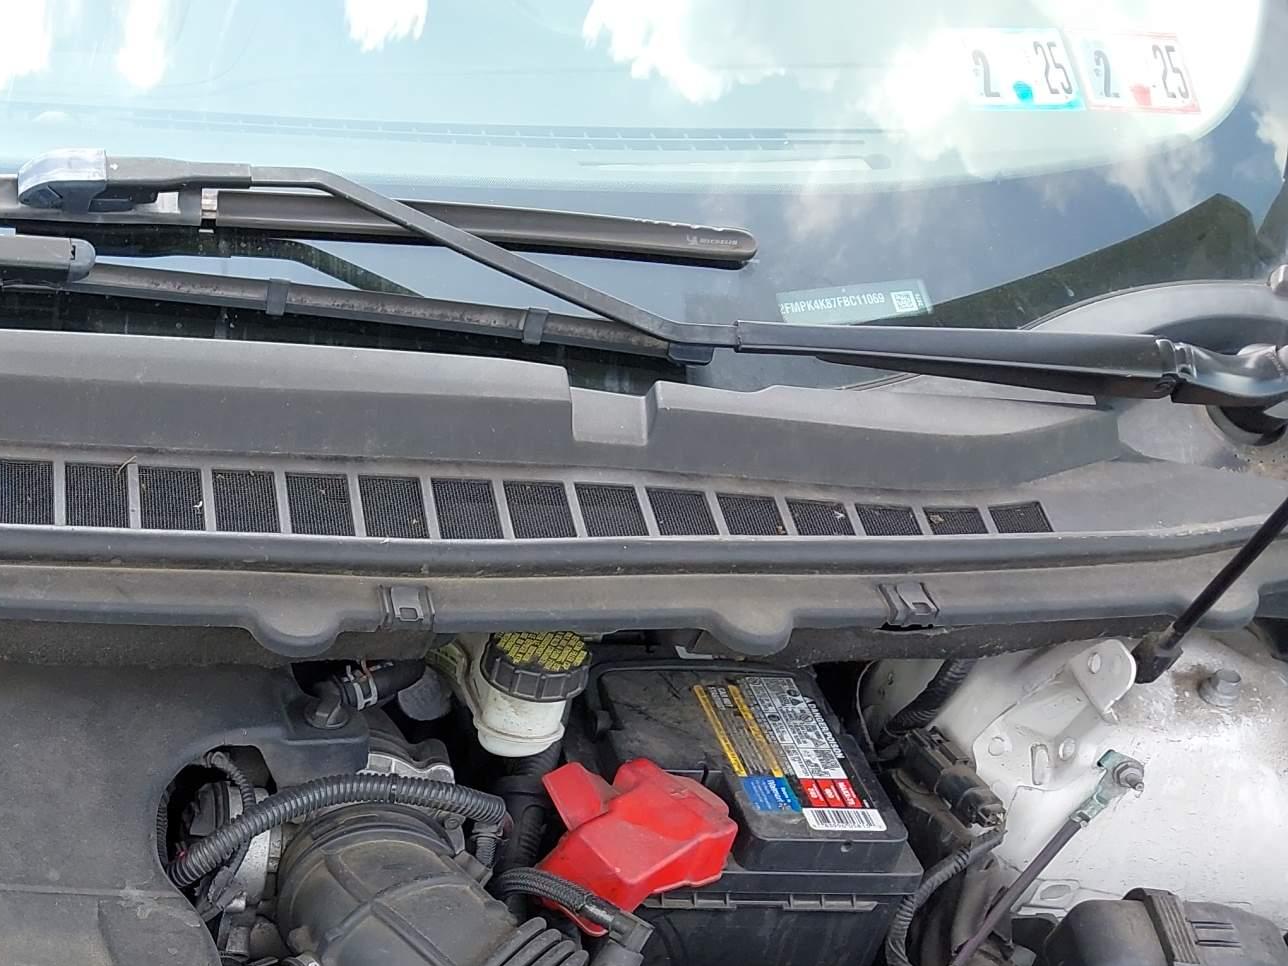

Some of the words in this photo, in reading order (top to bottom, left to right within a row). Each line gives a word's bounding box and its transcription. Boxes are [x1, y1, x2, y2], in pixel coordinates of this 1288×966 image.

[971, 49, 1001, 98] 2
[1033, 41, 1073, 95] 25
[1093, 49, 1121, 99] 2
[1152, 44, 1190, 99] 25
